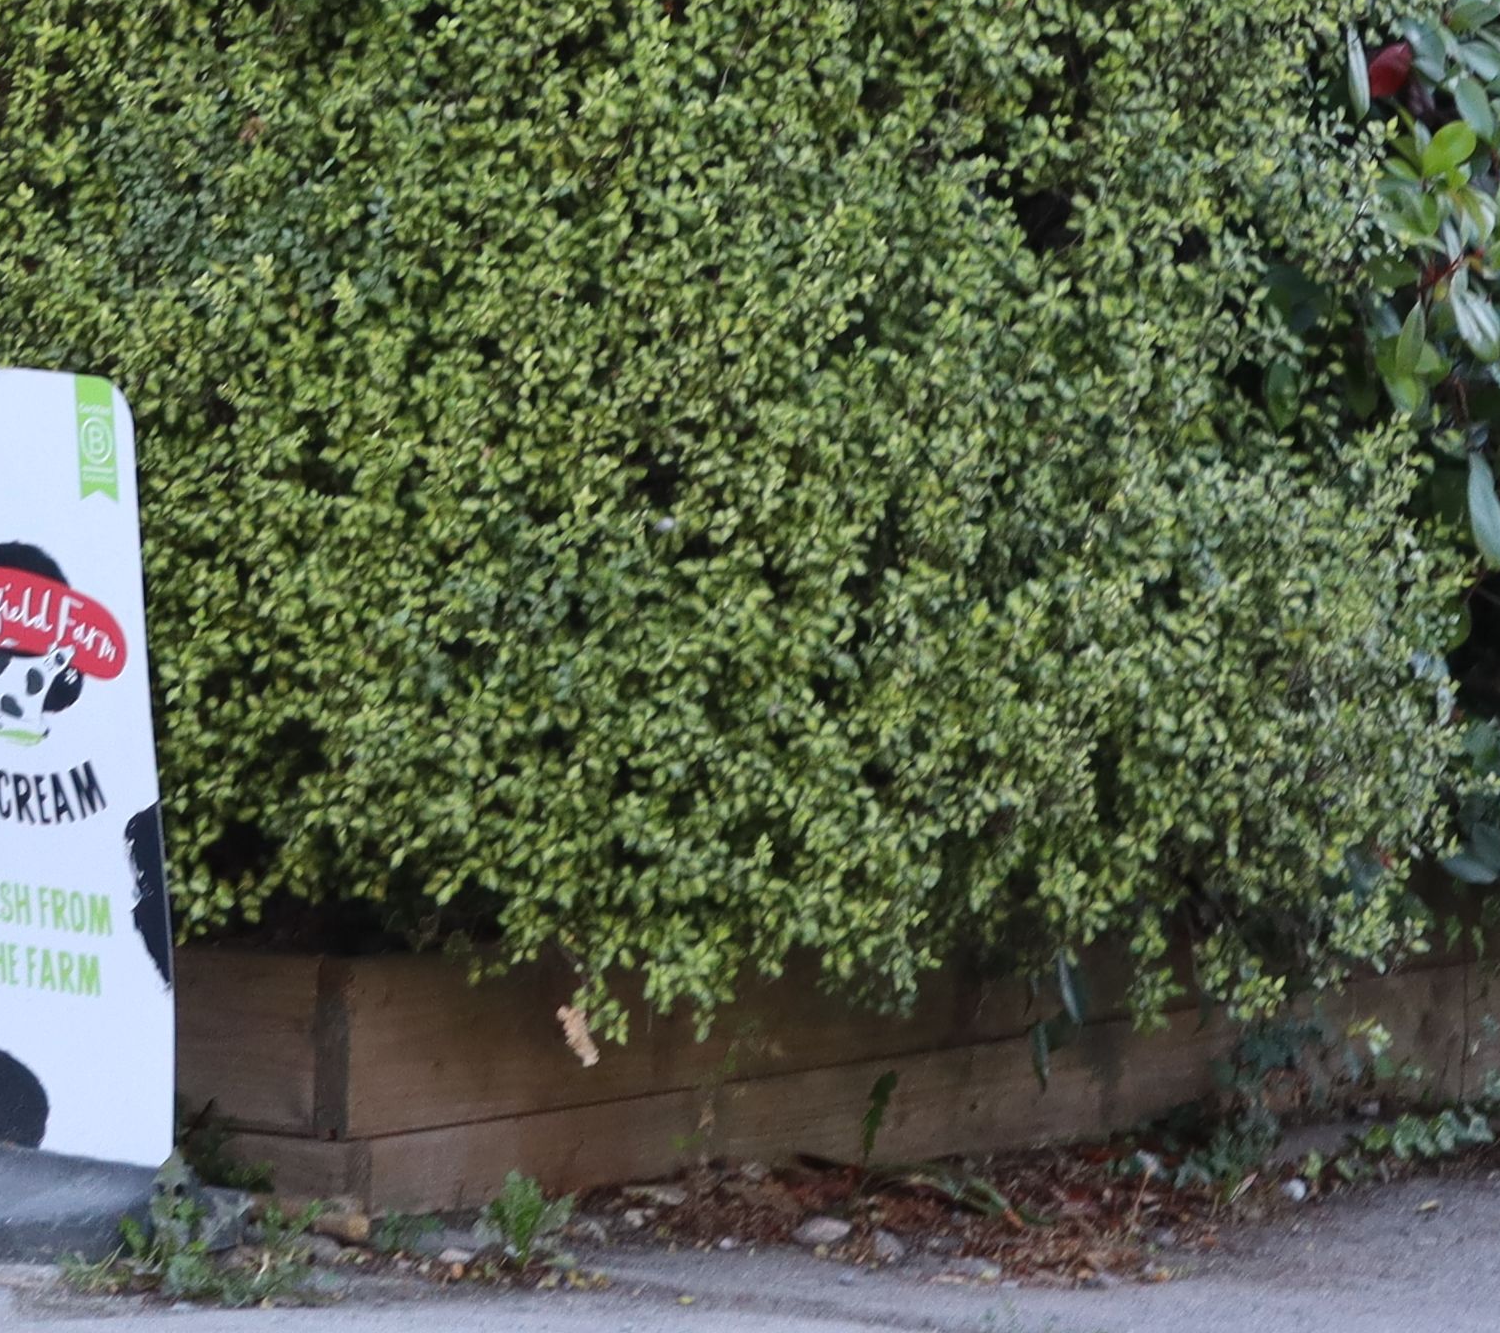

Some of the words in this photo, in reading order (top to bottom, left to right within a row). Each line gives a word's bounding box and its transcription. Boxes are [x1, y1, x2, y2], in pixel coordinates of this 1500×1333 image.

[56, 595, 118, 663] Farm
[38, 886, 113, 937] FROM
[26, 946, 102, 997] FARM
